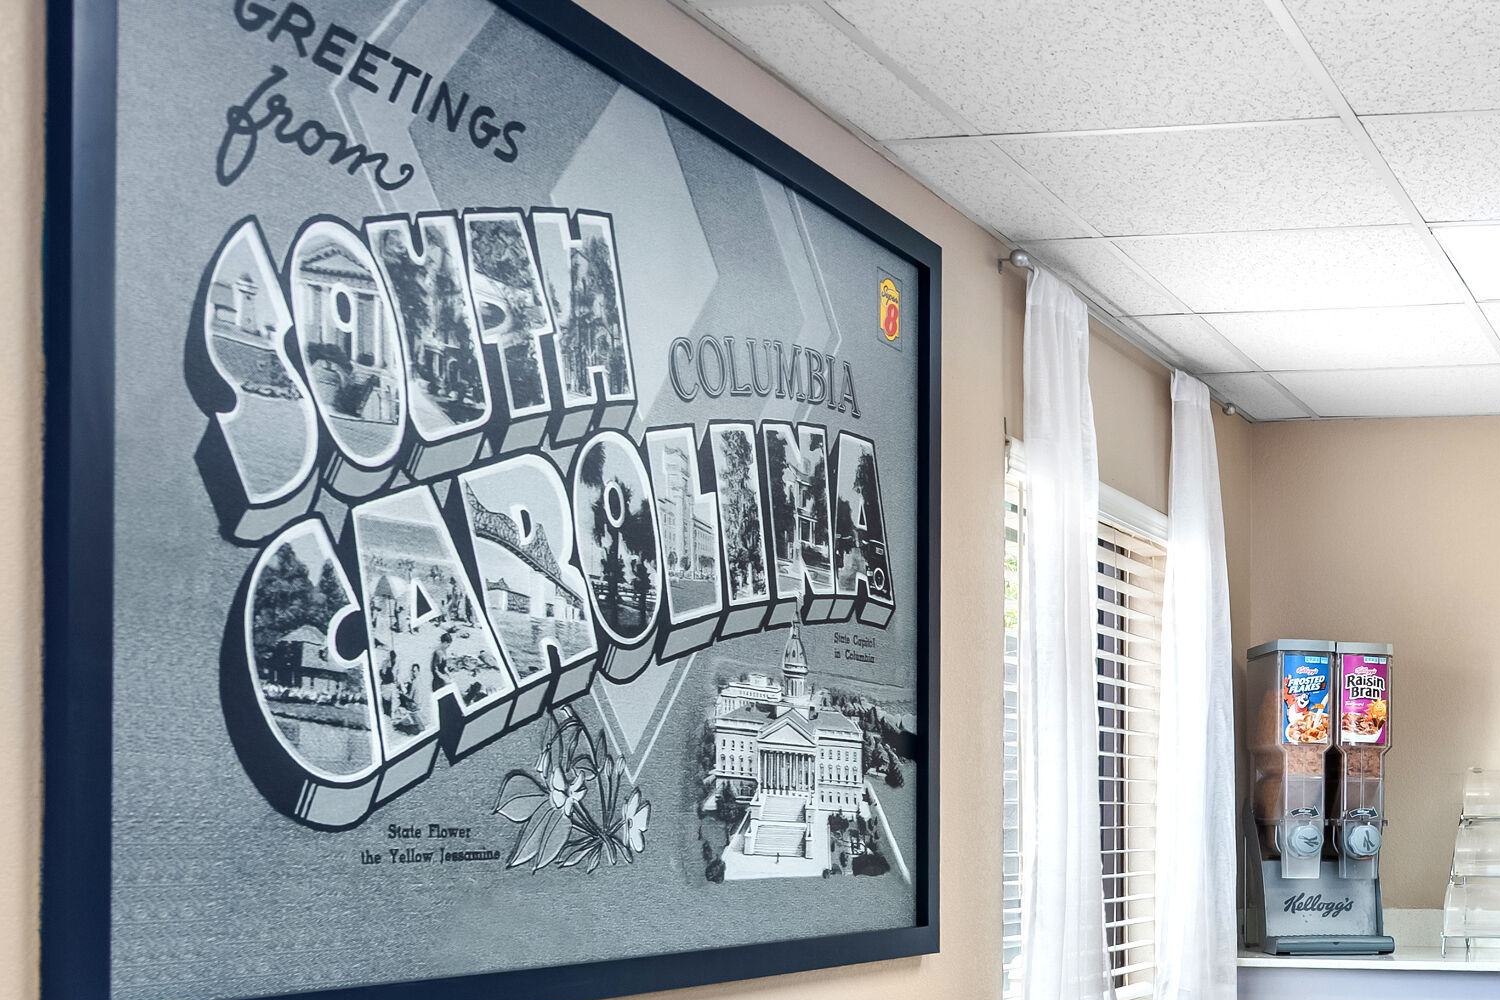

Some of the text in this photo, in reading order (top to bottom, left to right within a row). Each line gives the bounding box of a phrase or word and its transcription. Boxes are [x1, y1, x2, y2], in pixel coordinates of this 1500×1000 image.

[233, 0, 526, 163] GREETINGS
[216, 65, 414, 191] from
[884, 304, 898, 336] 8
[185, 207, 638, 547] SOUTH
[669, 335, 861, 418] COLUMBIA
[221, 419, 898, 832] CAROLINA
[1287, 675, 1325, 687] FROSTED
[1288, 682, 1321, 694] FLAKES
[1346, 674, 1384, 690] Raisin
[1350, 685, 1380, 699] Bran
[388, 824, 471, 838] State Flower
[361, 847, 500, 864] the Yellow Jessamine
[1284, 892, 1354, 918] Kellogg's
